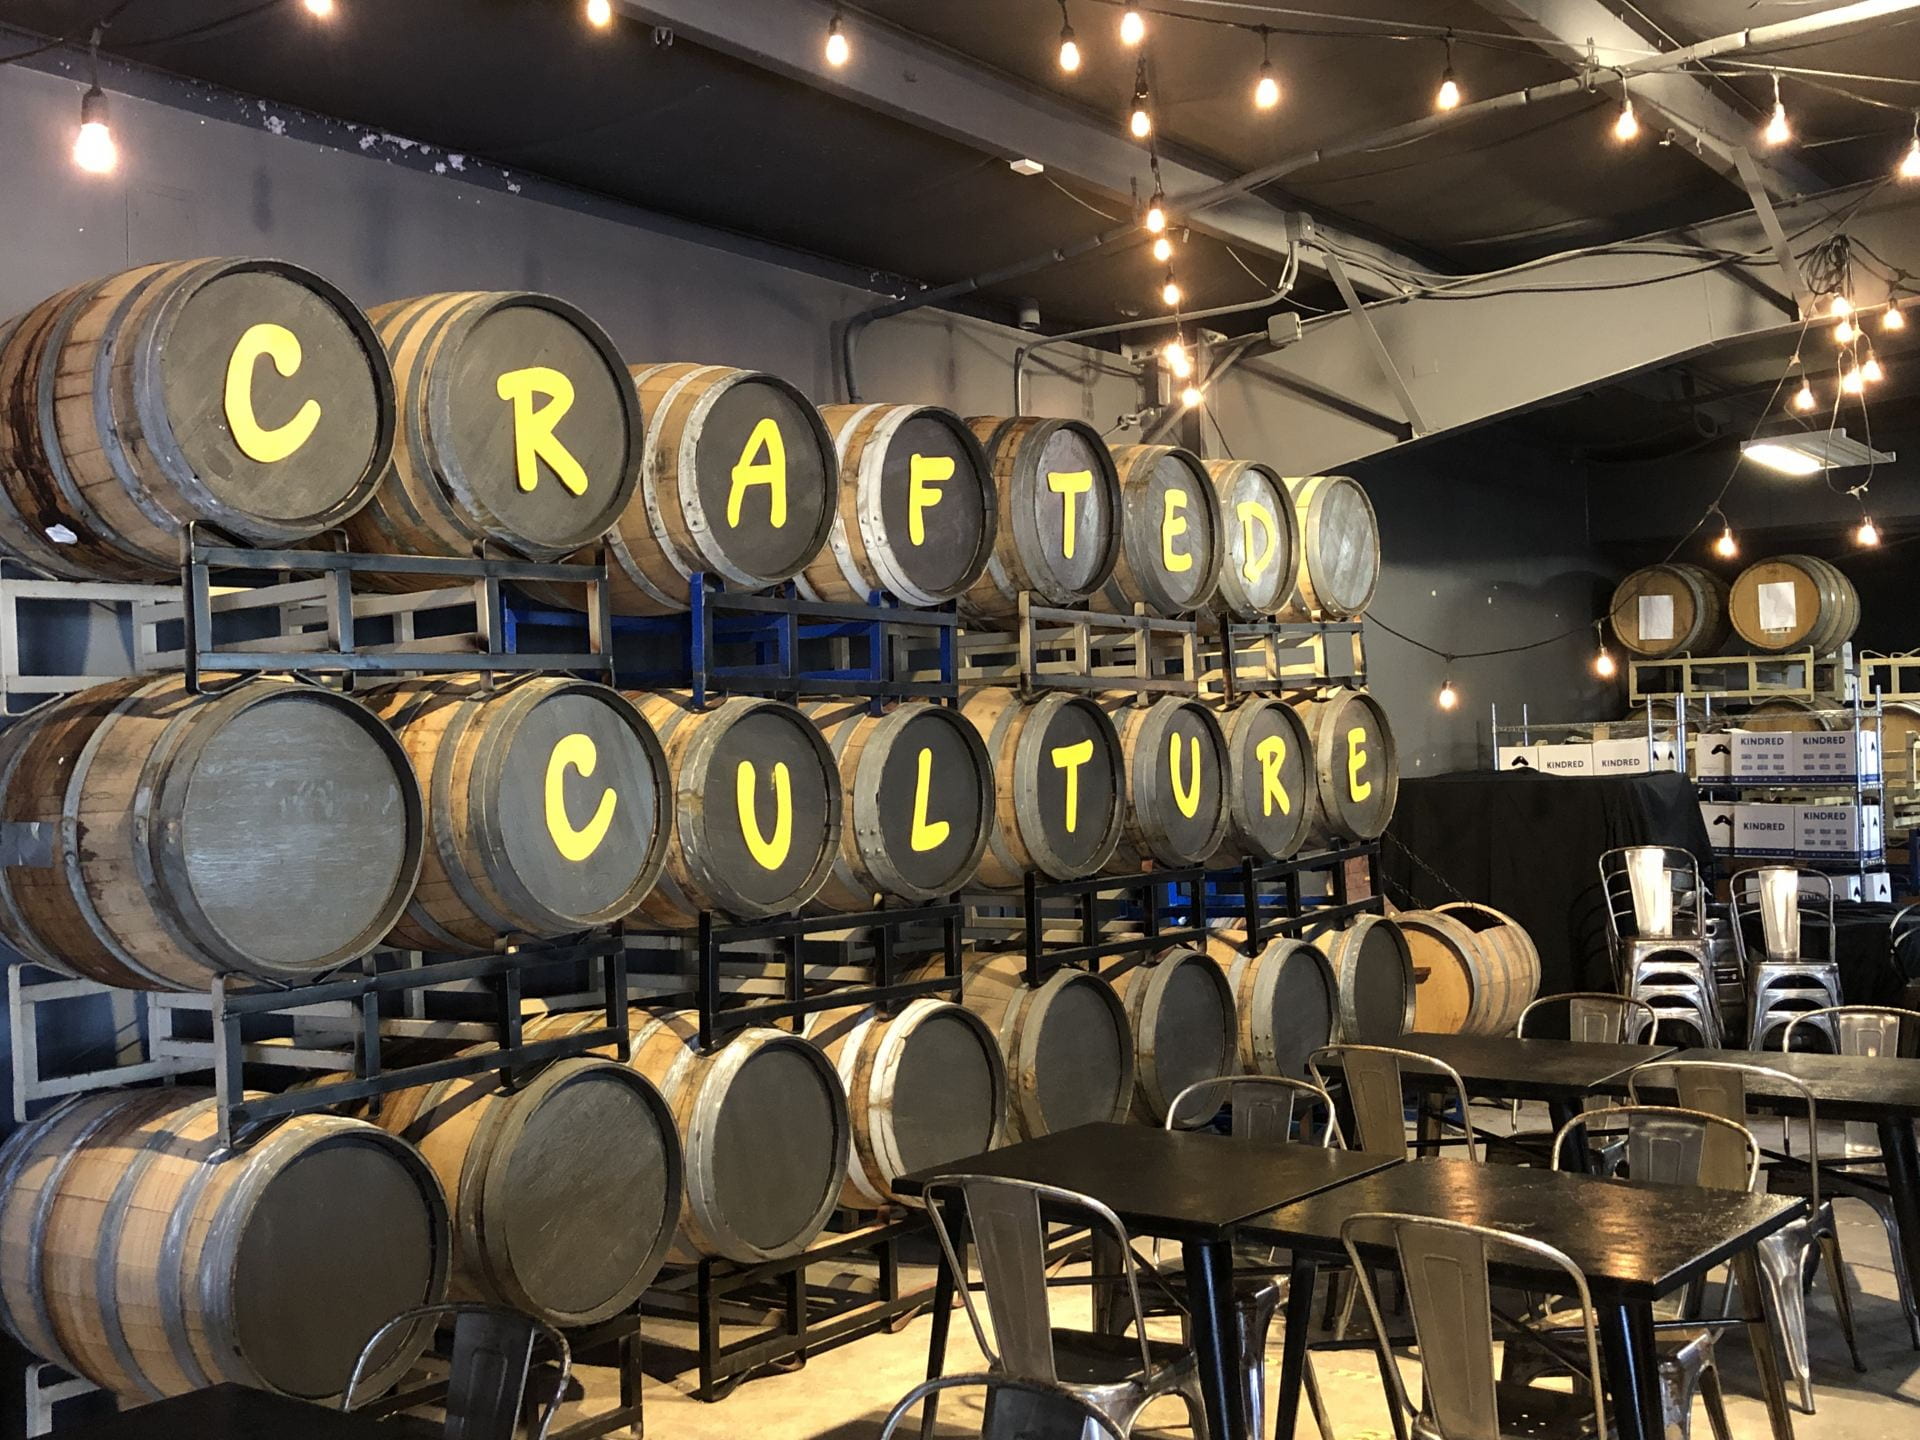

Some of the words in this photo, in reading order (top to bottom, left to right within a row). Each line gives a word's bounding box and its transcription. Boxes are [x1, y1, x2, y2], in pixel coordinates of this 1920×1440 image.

[222, 322, 1279, 586] CRAFTED
[1741, 737, 1785, 746] KINDRED
[1802, 736, 1846, 745] KINDRED
[1546, 760, 1584, 769] KINDRED
[1601, 758, 1641, 767] KINDRED
[544, 725, 1373, 871] CULTURE
[1803, 811, 1847, 820] KINDRED
[1743, 822, 1785, 831] KINDRED
